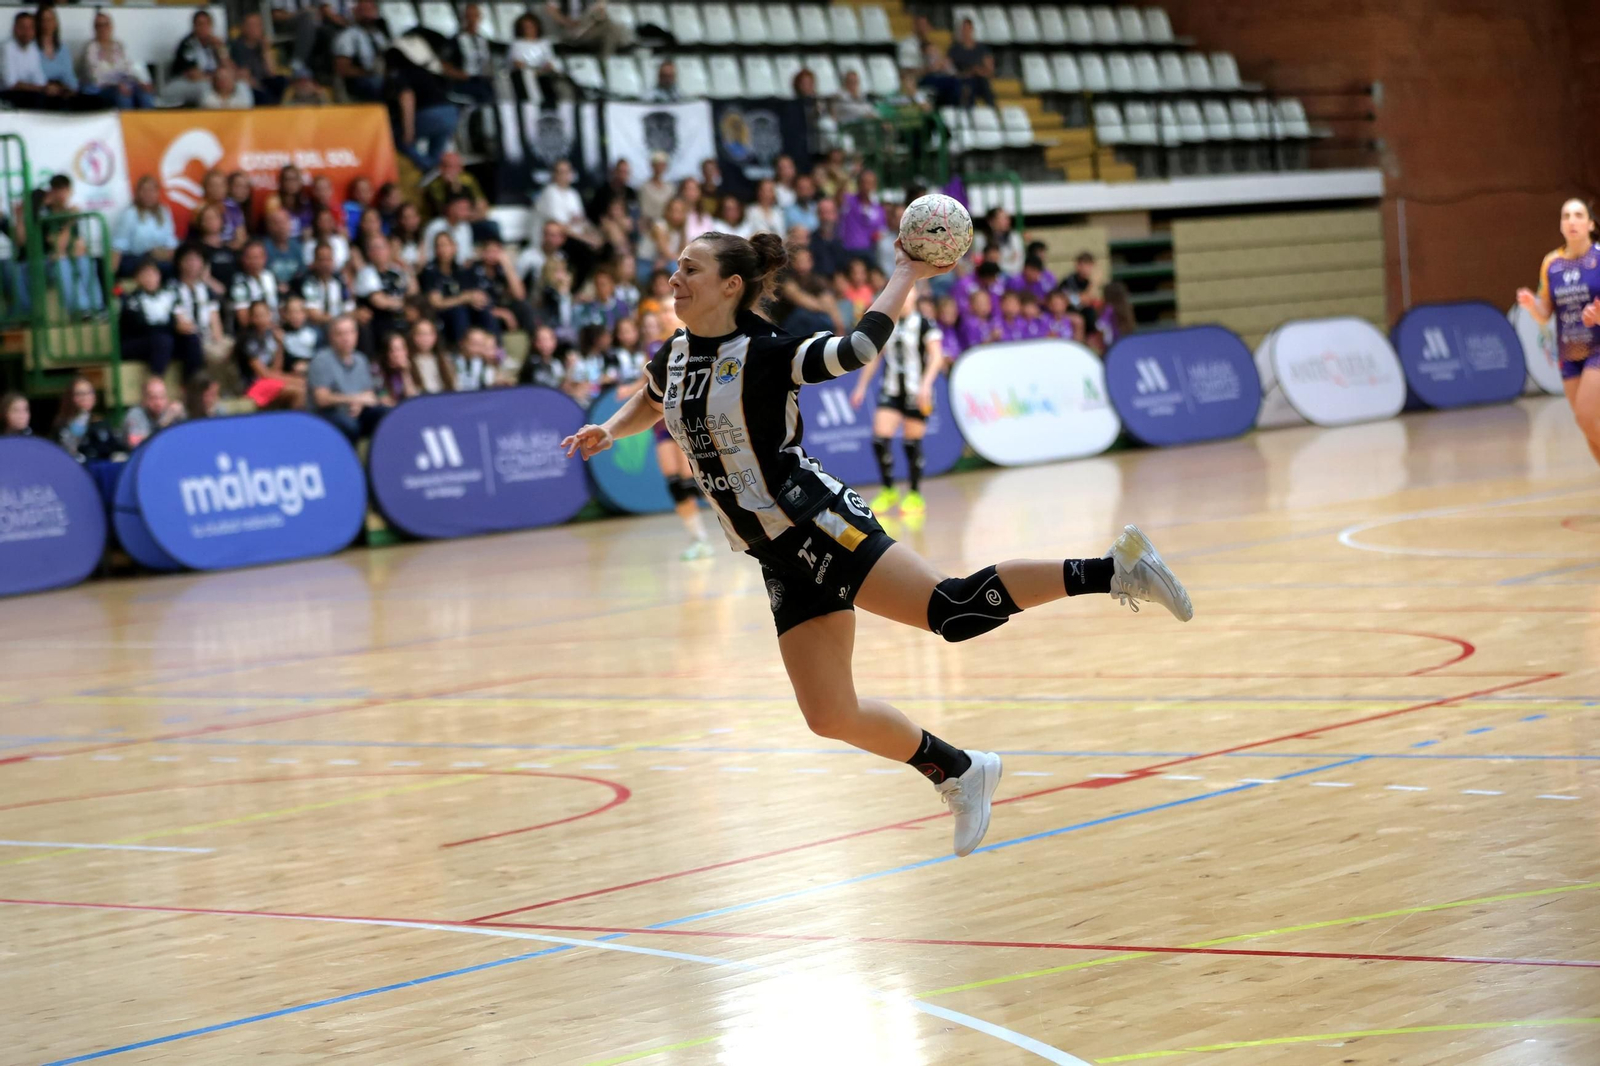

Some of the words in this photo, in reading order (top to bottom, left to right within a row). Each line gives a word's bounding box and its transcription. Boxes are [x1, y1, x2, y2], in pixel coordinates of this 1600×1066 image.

[684, 368, 711, 400] 27
[180, 452, 326, 516] málaga
[699, 469, 756, 494] álaga
